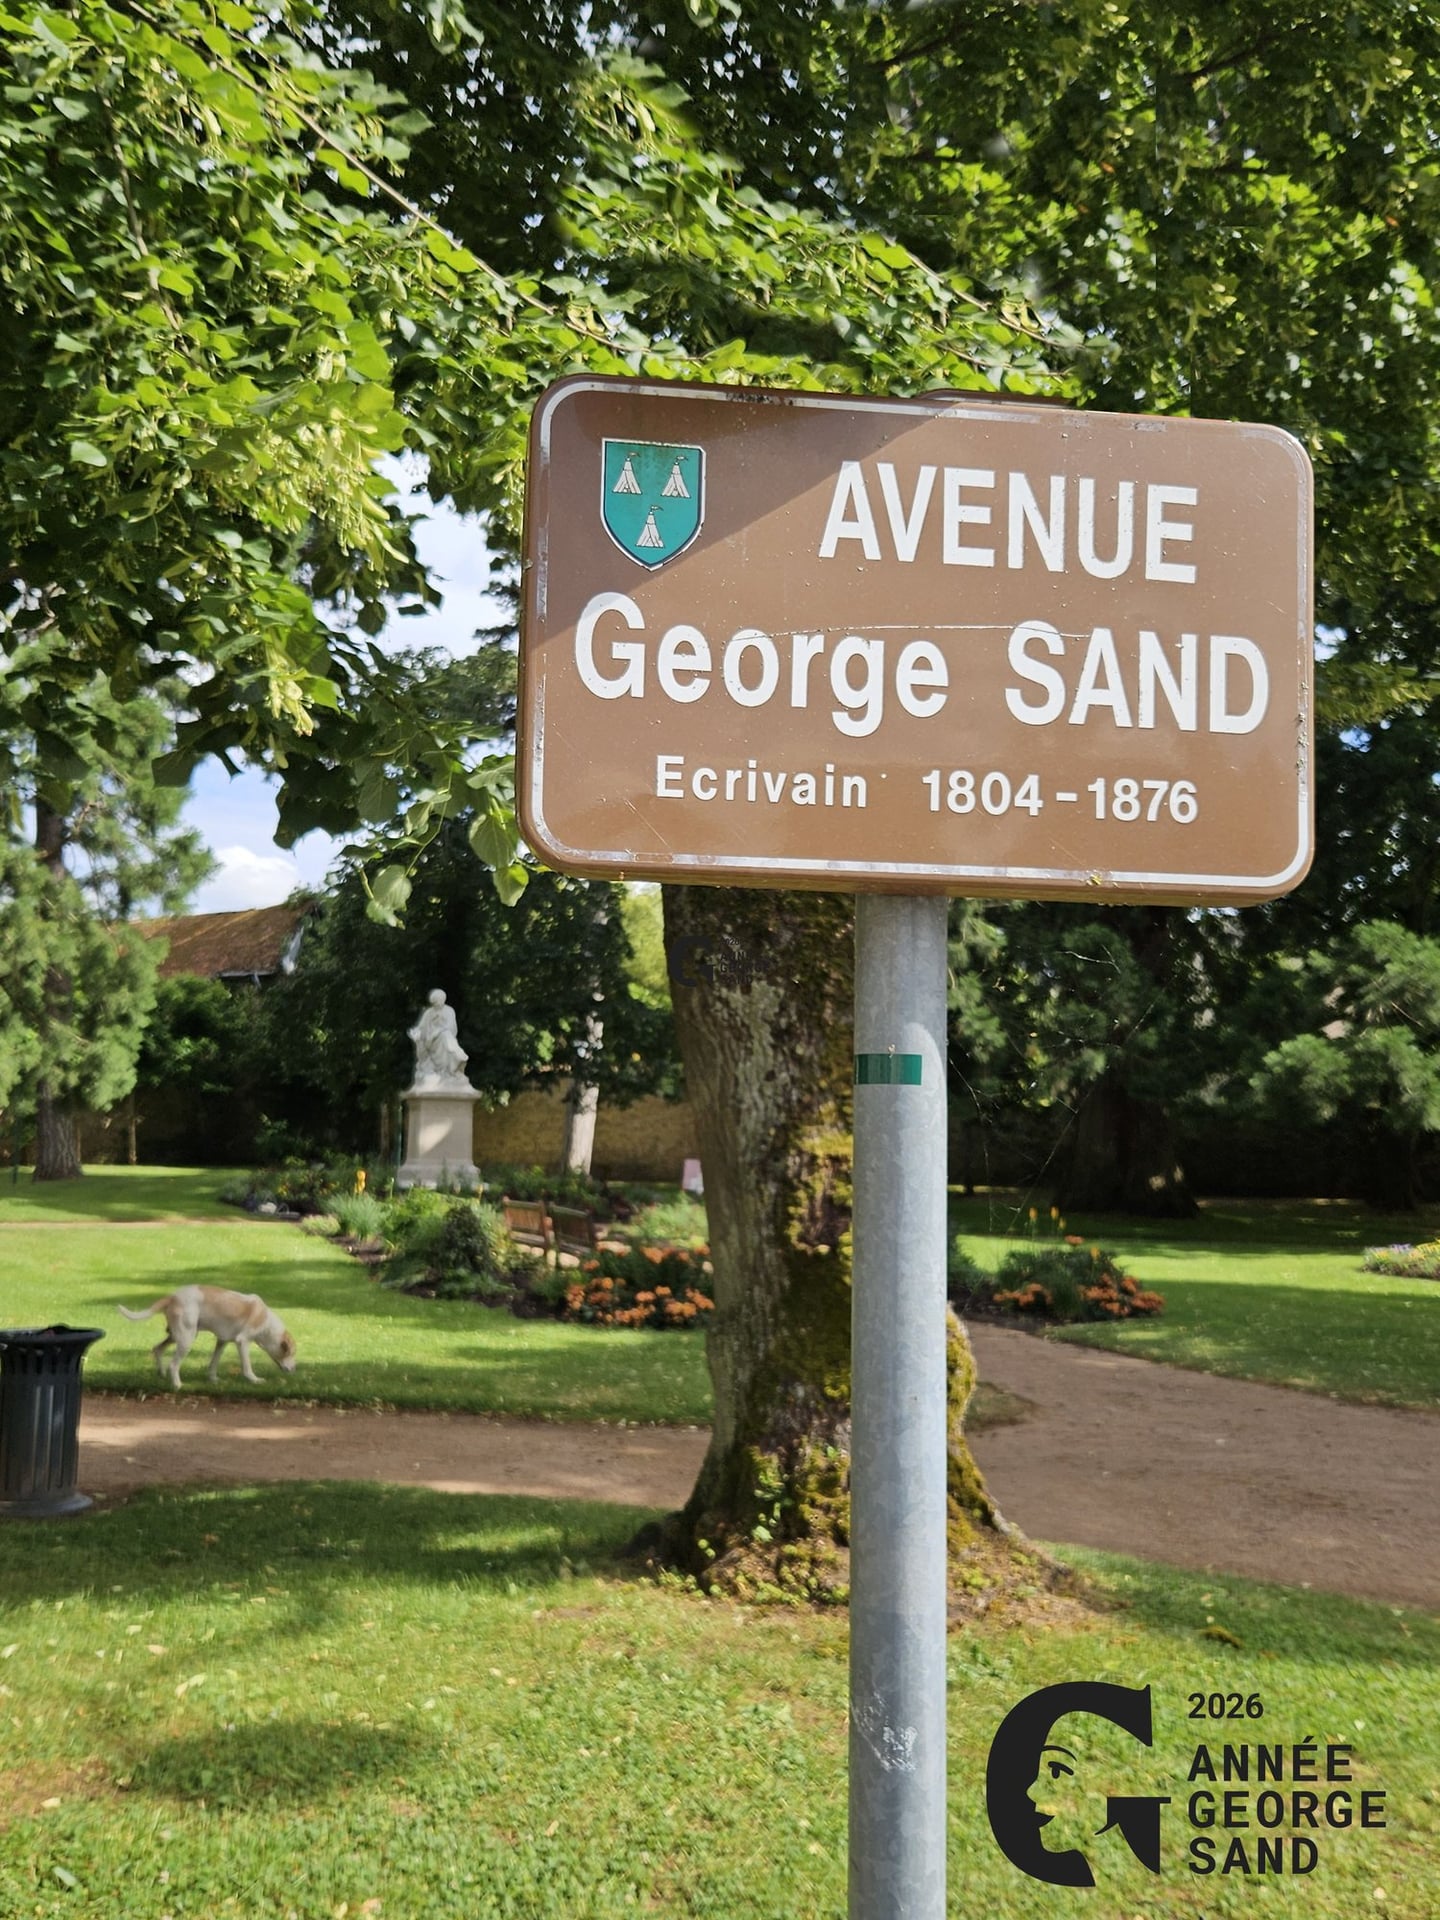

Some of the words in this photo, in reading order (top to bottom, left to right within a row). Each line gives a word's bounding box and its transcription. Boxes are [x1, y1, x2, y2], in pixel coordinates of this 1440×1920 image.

[818, 461, 1198, 584] AVENUE
[574, 591, 949, 737] George
[1005, 619, 1269, 734] SAND
[655, 753, 868, 808] Ecrivain
